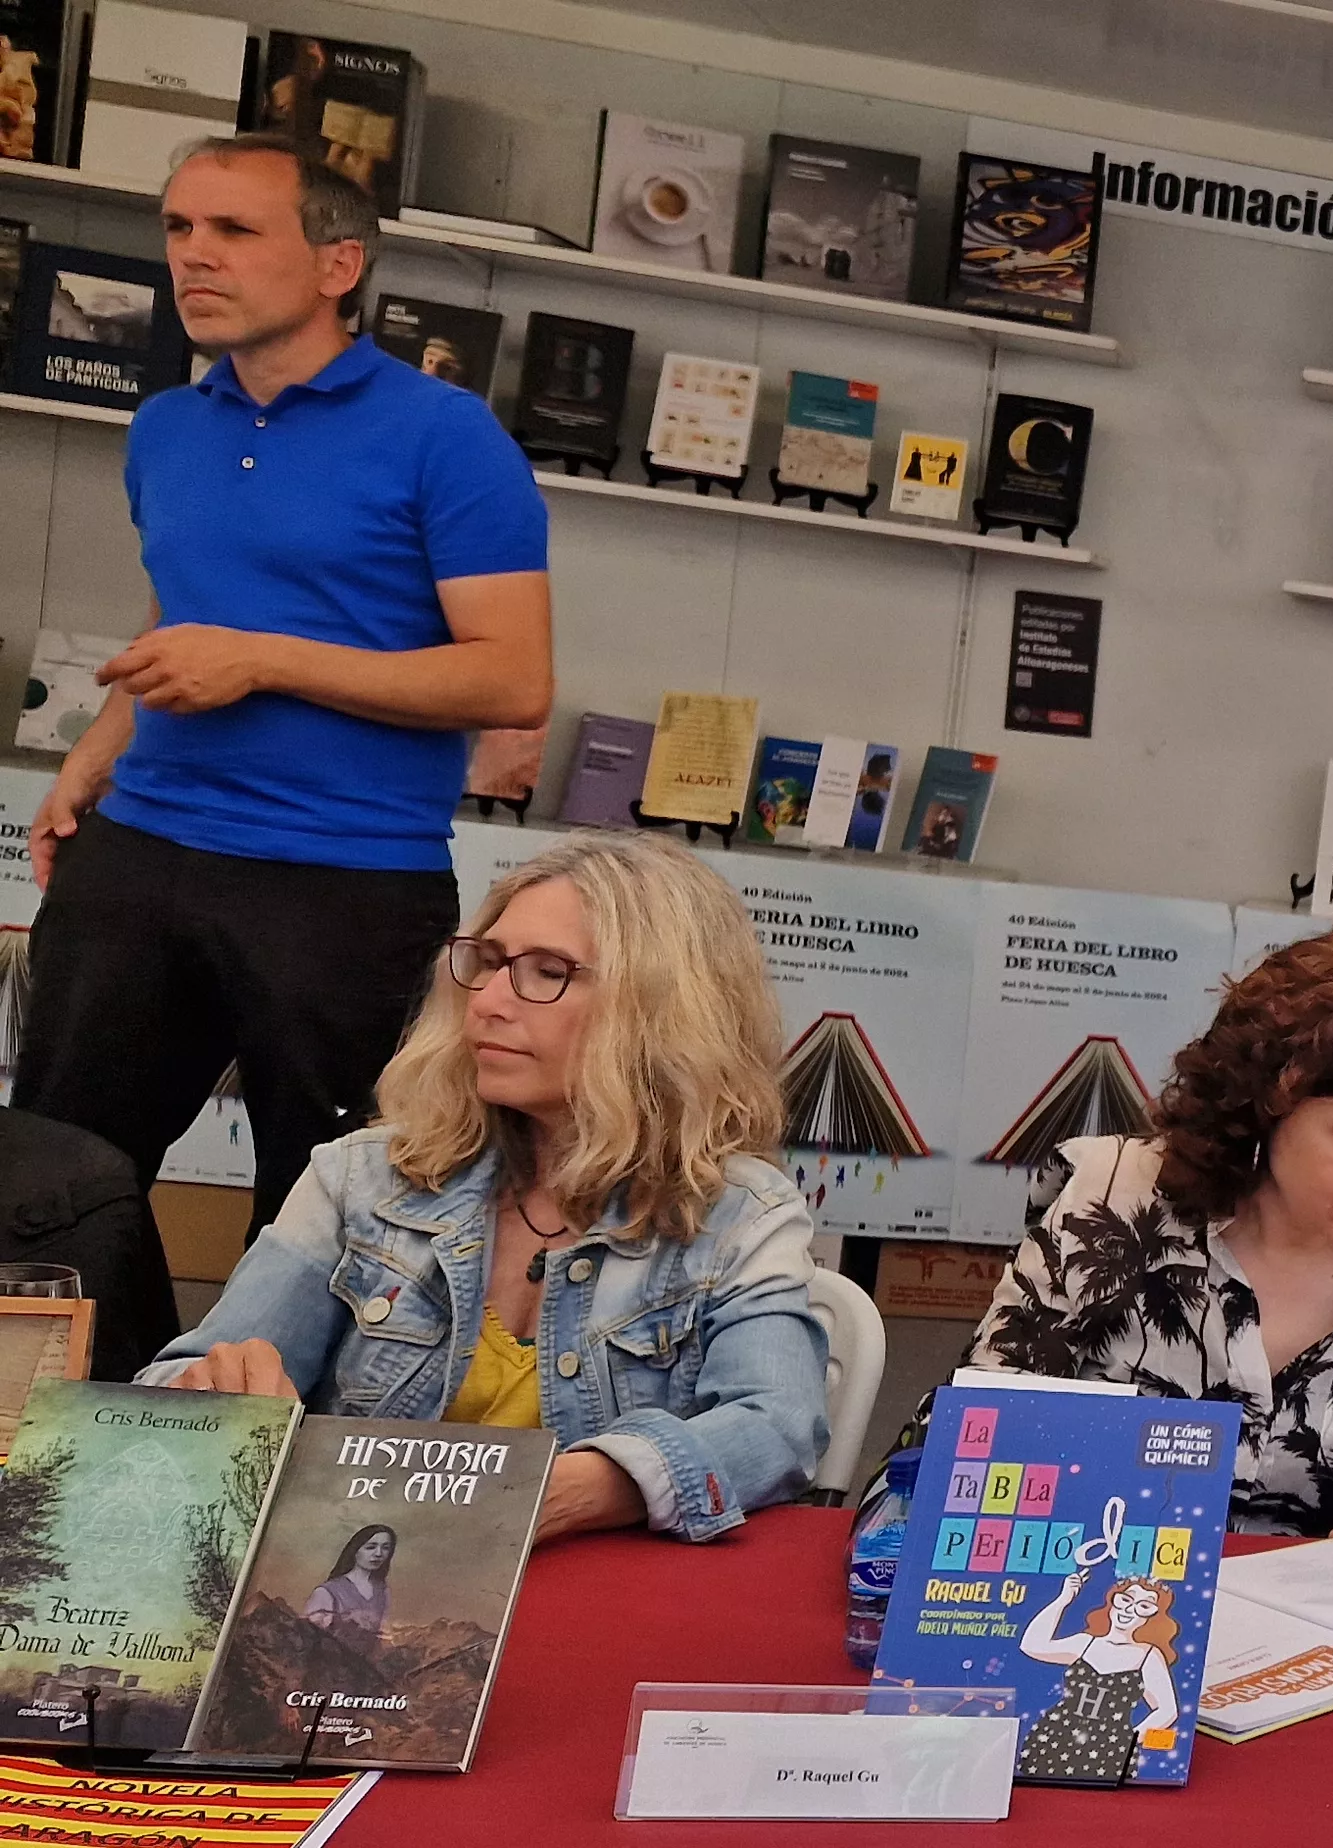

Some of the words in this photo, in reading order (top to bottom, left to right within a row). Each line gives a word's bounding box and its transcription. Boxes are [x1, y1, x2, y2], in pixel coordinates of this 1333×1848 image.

[762, 887, 813, 904] Edición
[809, 914, 852, 933] DEL
[855, 919, 920, 940] LIBRO
[1008, 914, 1025, 925] 40
[1028, 915, 1077, 930] Edición
[770, 931, 856, 954] HUESCA
[1006, 934, 1069, 953] FERIA
[1073, 940, 1113, 957] DEL
[1116, 944, 1179, 963] LIBRO
[1004, 954, 1032, 971] DE
[1036, 957, 1118, 978] HUESCA
[94, 1407, 135, 1426] Cris
[138, 1410, 220, 1434] Bernadó
[1150, 1424, 1170, 1438] UN
[962, 1420, 990, 1445] La
[336, 1434, 511, 1475] HISTORIA
[1147, 1437, 1170, 1450] CON
[1173, 1438, 1212, 1452] MUCHA
[346, 1476, 388, 1500] DE
[403, 1471, 480, 1506] AVA
[924, 1578, 993, 1604] RAQUEL
[46, 1595, 131, 1628] Beatriz
[984, 1611, 1006, 1622] POR
[916, 1620, 949, 1636] ADELA
[951, 1621, 989, 1637] MUÑOZ
[990, 1620, 1019, 1638] PÁEZ
[0, 1623, 62, 1655] Dama
[70, 1633, 97, 1657] de
[105, 1630, 196, 1663] Vallbona
[32, 1699, 70, 1711] Platero
[285, 1690, 326, 1707] Cris
[328, 1691, 408, 1711] Bernadó
[68, 1779, 239, 1798] NOVELA
[802, 1769, 854, 1785] Raquel
[857, 1770, 880, 1783] Gu
[223, 1812, 282, 1826] DE
[1, 1823, 203, 1848] ARAGÓN
